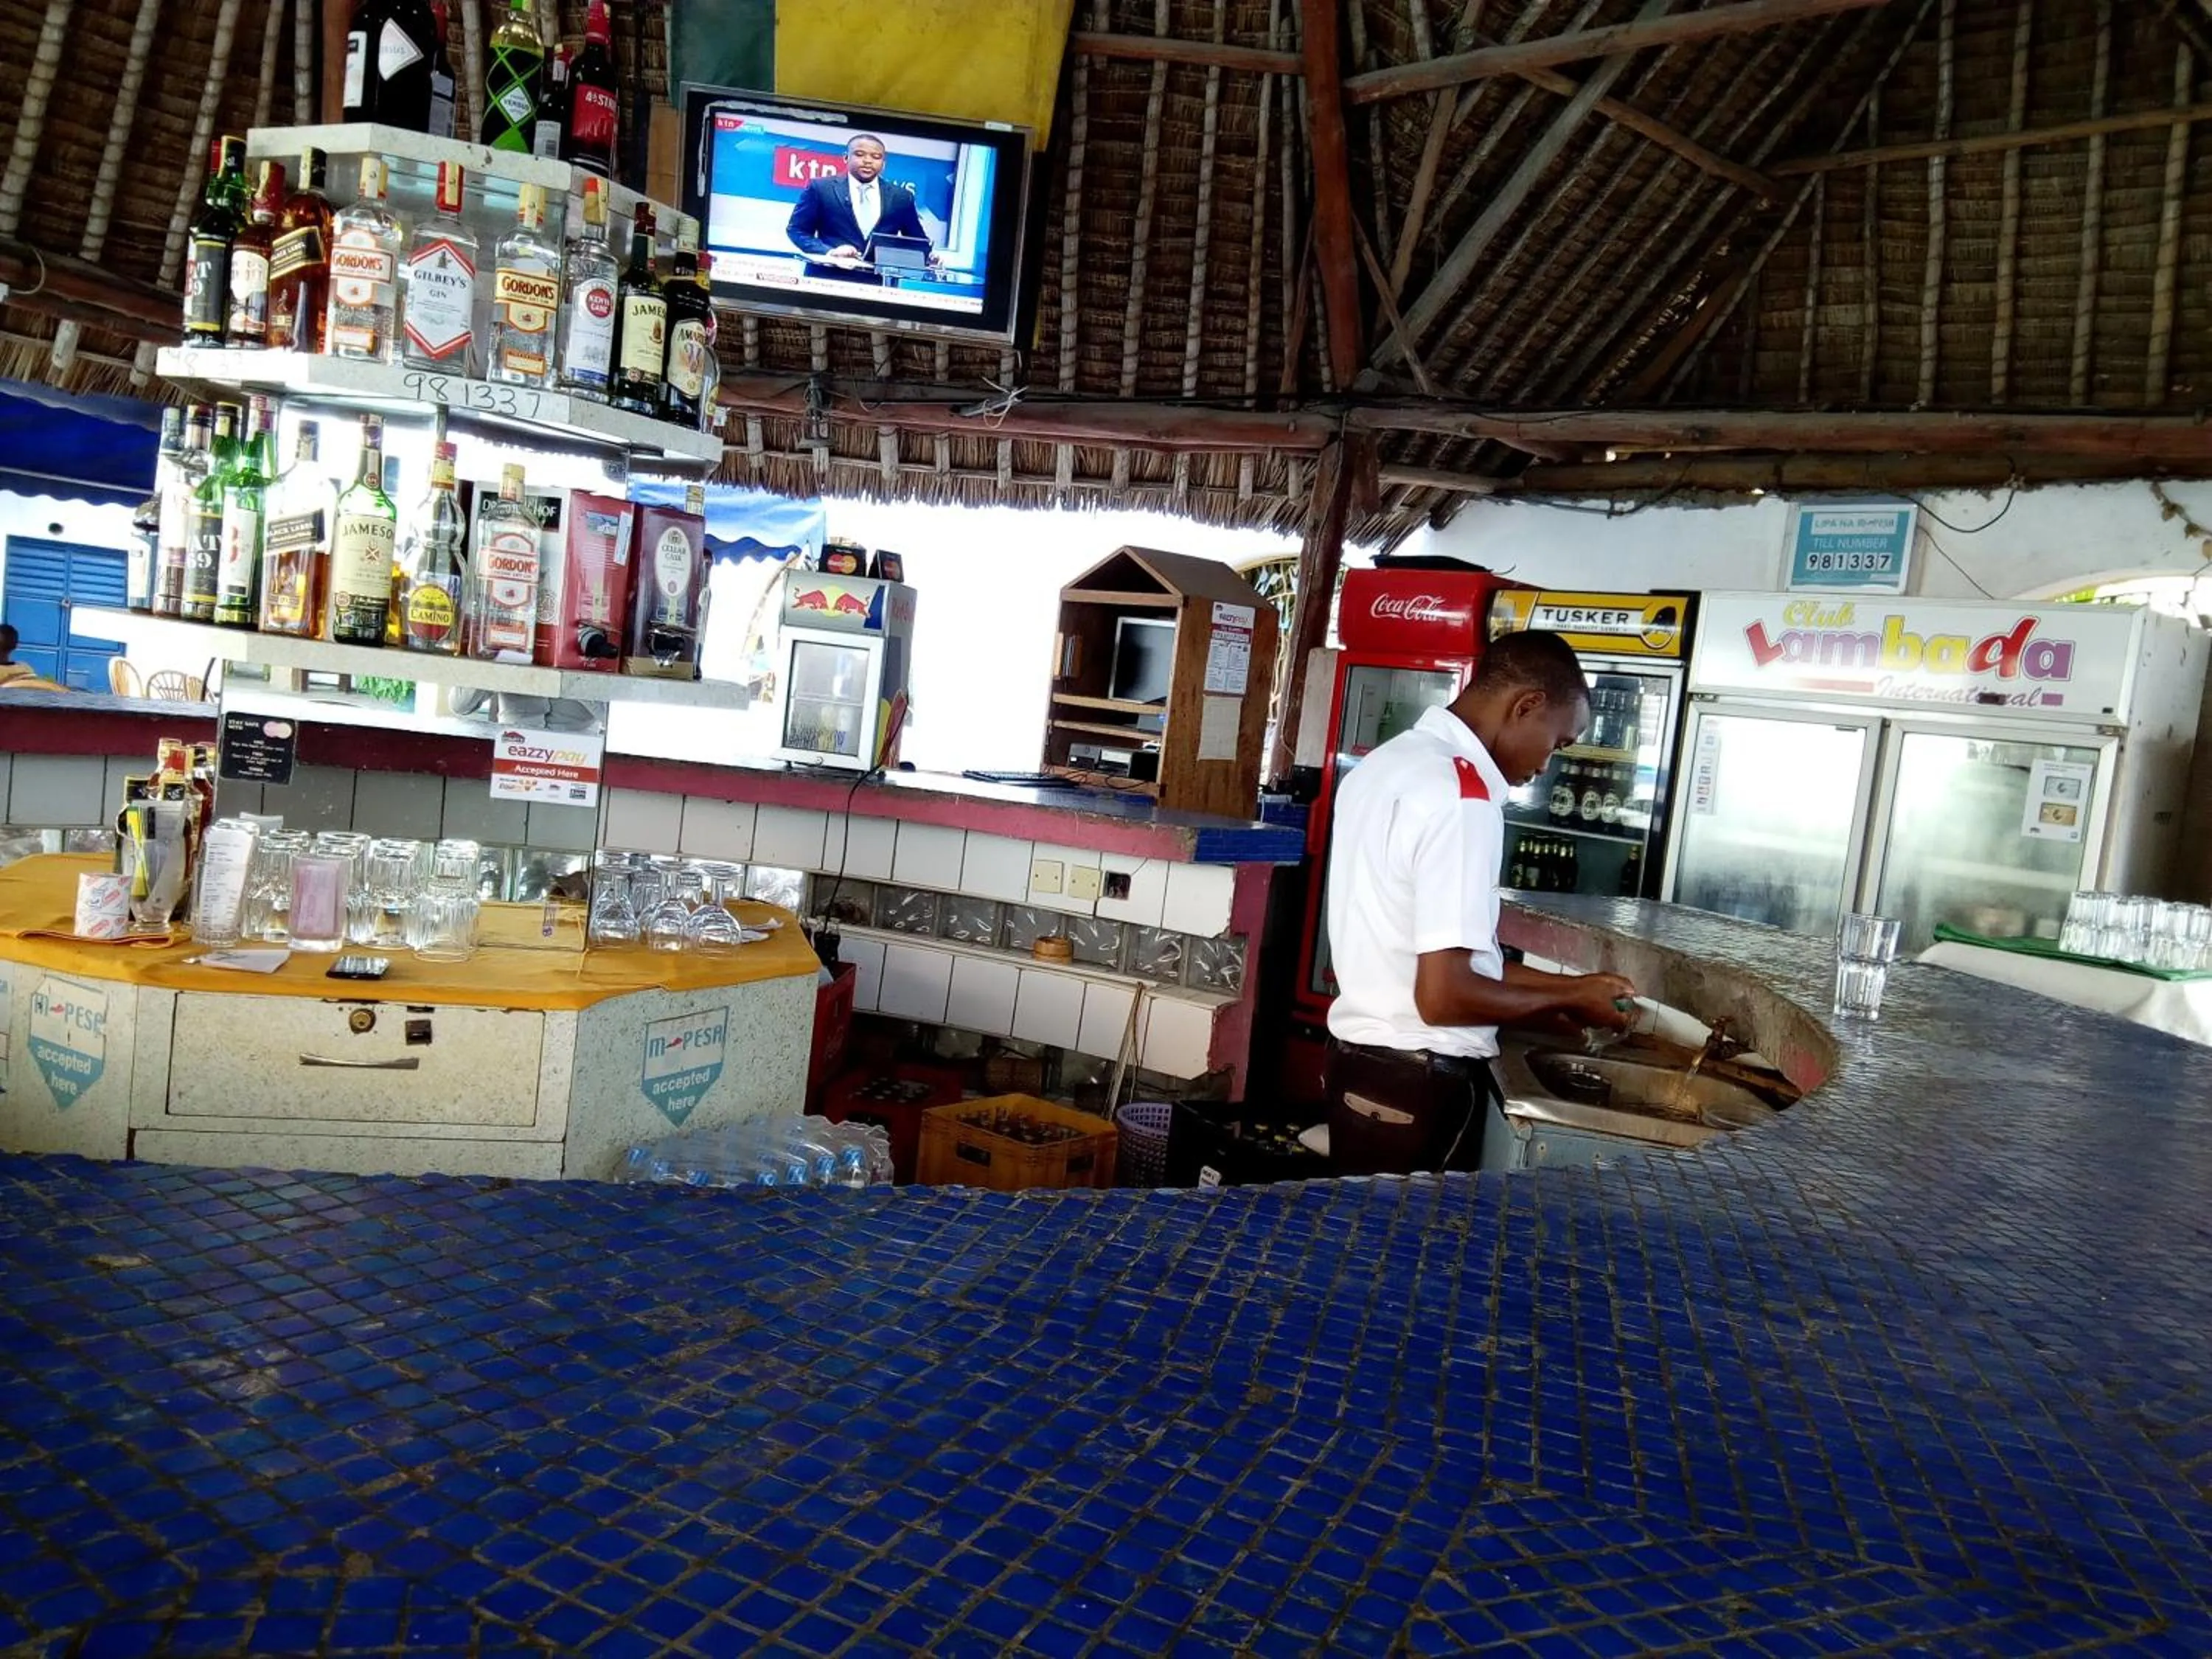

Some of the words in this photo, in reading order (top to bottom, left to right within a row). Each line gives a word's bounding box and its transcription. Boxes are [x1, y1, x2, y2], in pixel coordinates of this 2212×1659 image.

[414, 269, 467, 288] GILBEY'S
[404, 373, 540, 418] 981337
[342, 523, 393, 540] JAMESO
[1814, 537, 1834, 549] TILL
[1837, 538, 1889, 549] NUMBER
[1808, 554, 1891, 569] 981337
[1542, 608, 1630, 625] TUSKER
[1783, 600, 1856, 628] Club
[1743, 615, 2076, 681] Lambada
[1877, 675, 2042, 707] Internatinal
[515, 764, 555, 777] Accepted
[557, 769, 580, 779] Here
[37, 1045, 92, 1074] accepted
[51, 1073, 78, 1096] here
[653, 1068, 710, 1095] accepted
[667, 1094, 695, 1110] here
